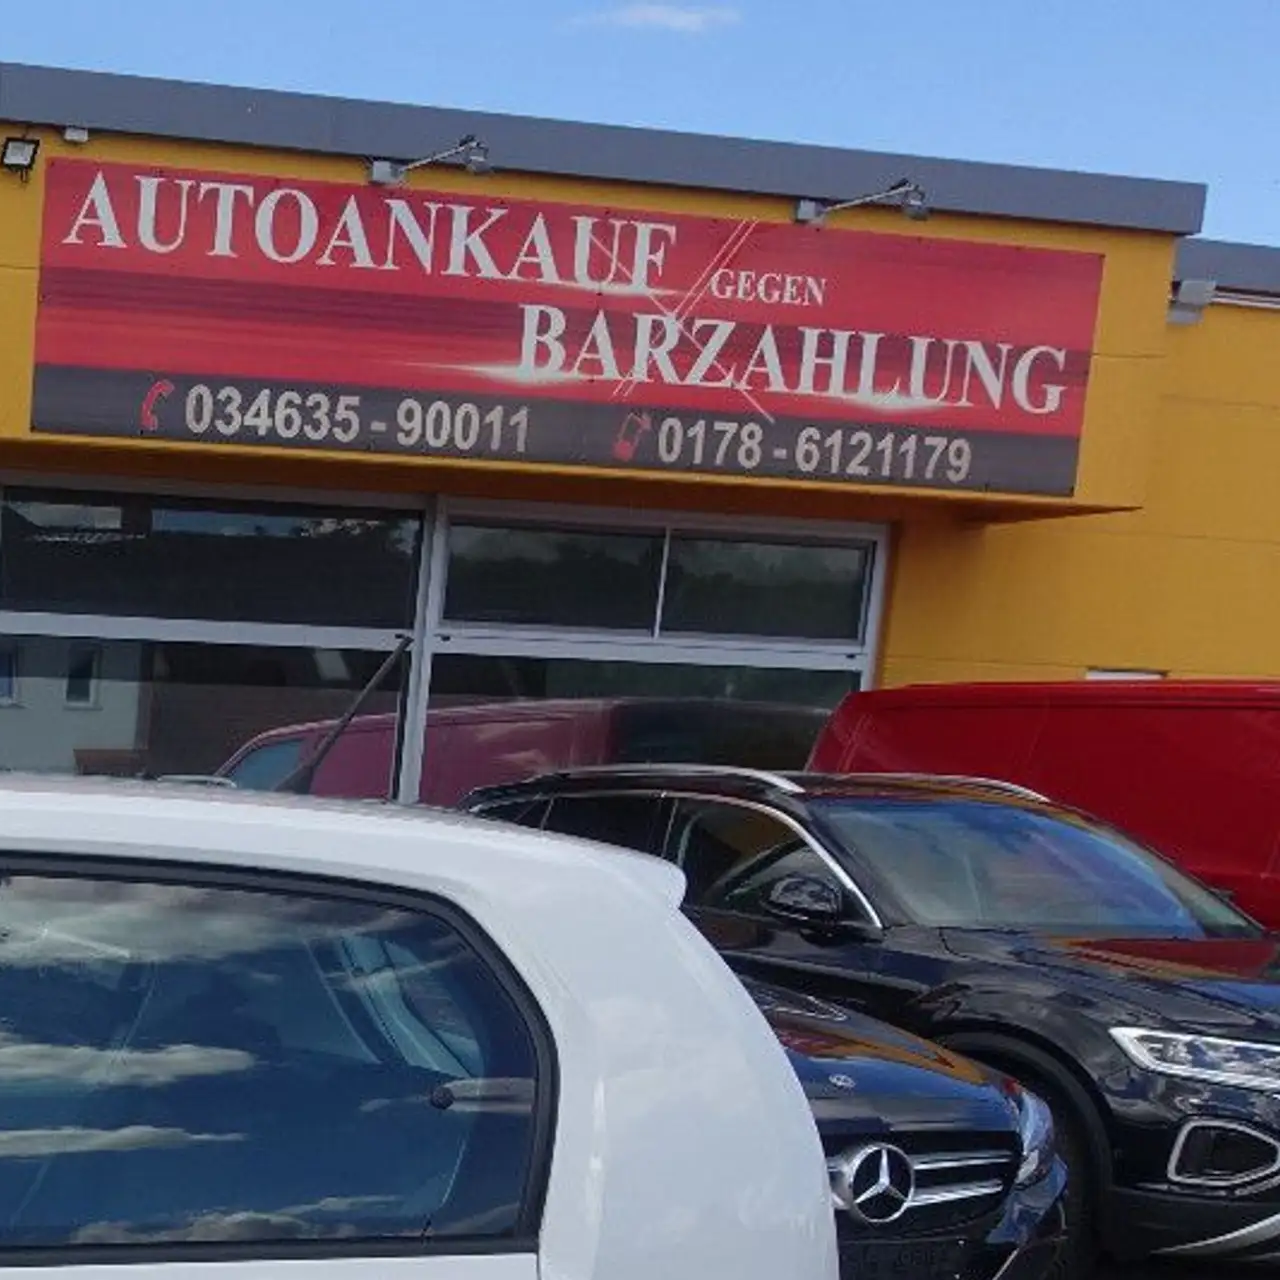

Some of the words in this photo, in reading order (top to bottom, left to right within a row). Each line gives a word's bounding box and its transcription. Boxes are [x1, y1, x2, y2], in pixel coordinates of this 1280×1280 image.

[61, 169, 678, 292] AUTOANKAUF
[709, 267, 827, 307] GEGEN
[516, 303, 1069, 415] BARZAHLUNG
